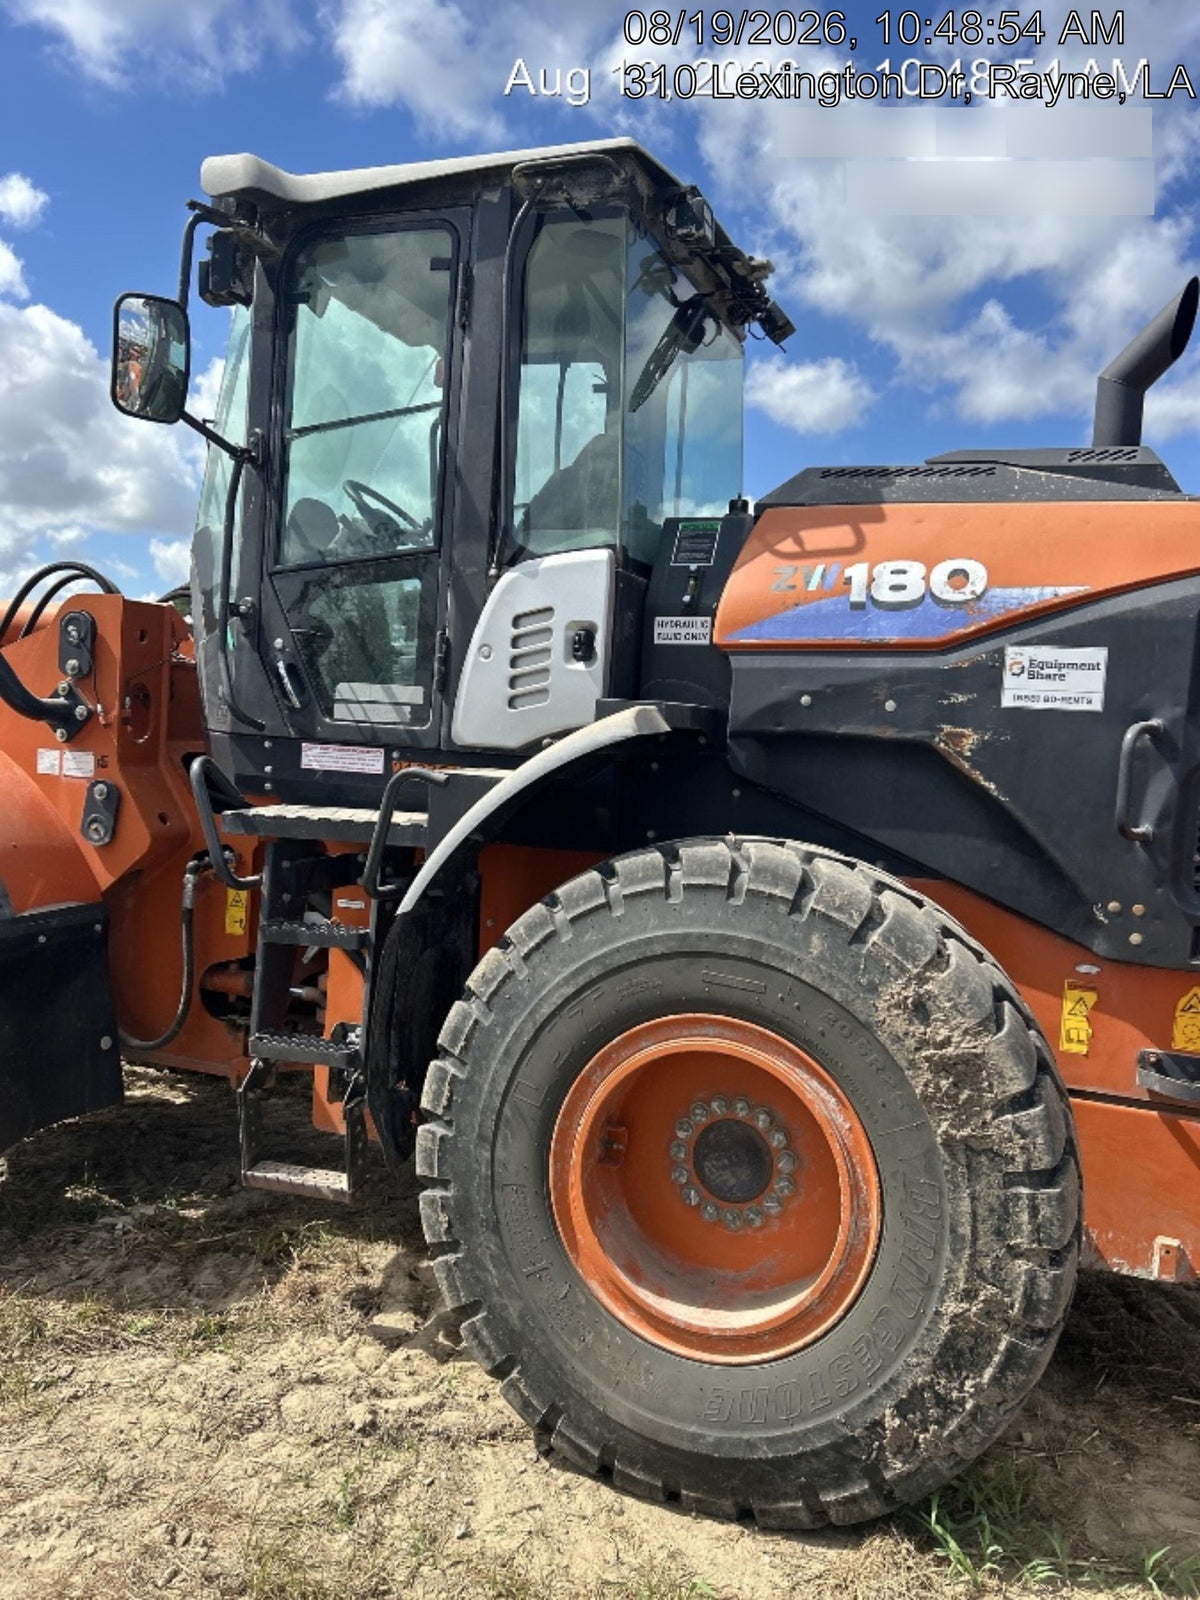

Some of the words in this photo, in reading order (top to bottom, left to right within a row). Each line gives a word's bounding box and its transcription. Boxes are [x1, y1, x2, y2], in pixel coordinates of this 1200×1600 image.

[657, 620, 709, 629] HYDRAULIC
[657, 632, 682, 641] FLUID
[684, 632, 708, 641] ONLY
[1028, 659, 1102, 672] Equipment
[1027, 670, 1067, 681] Share
[698, 1173, 942, 1425] BRIDGESTONE
